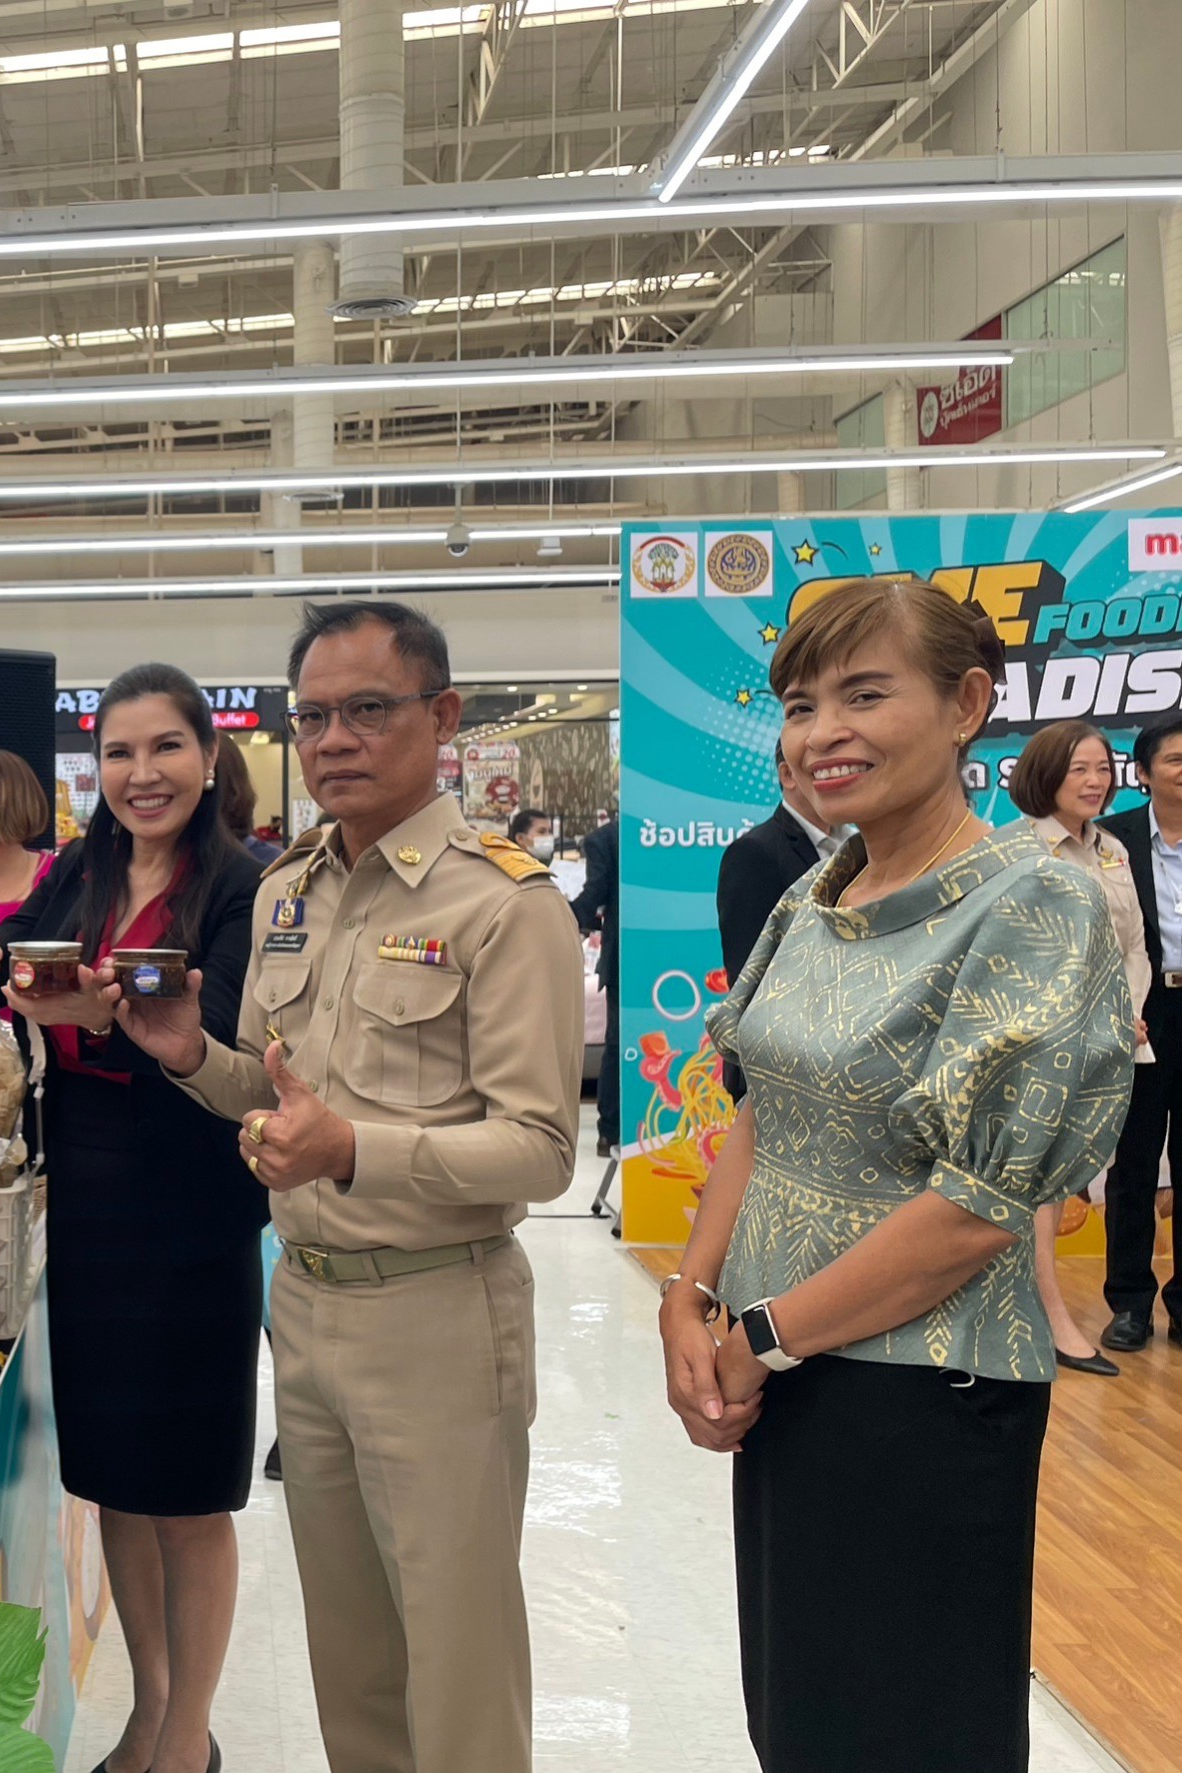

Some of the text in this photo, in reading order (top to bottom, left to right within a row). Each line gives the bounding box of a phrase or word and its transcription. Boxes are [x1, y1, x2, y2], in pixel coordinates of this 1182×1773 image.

[1145, 533, 1182, 556] m
[1032, 594, 1182, 645] FOOD
[987, 650, 1182, 723] ADIS
[211, 712, 246, 727] Buffet
